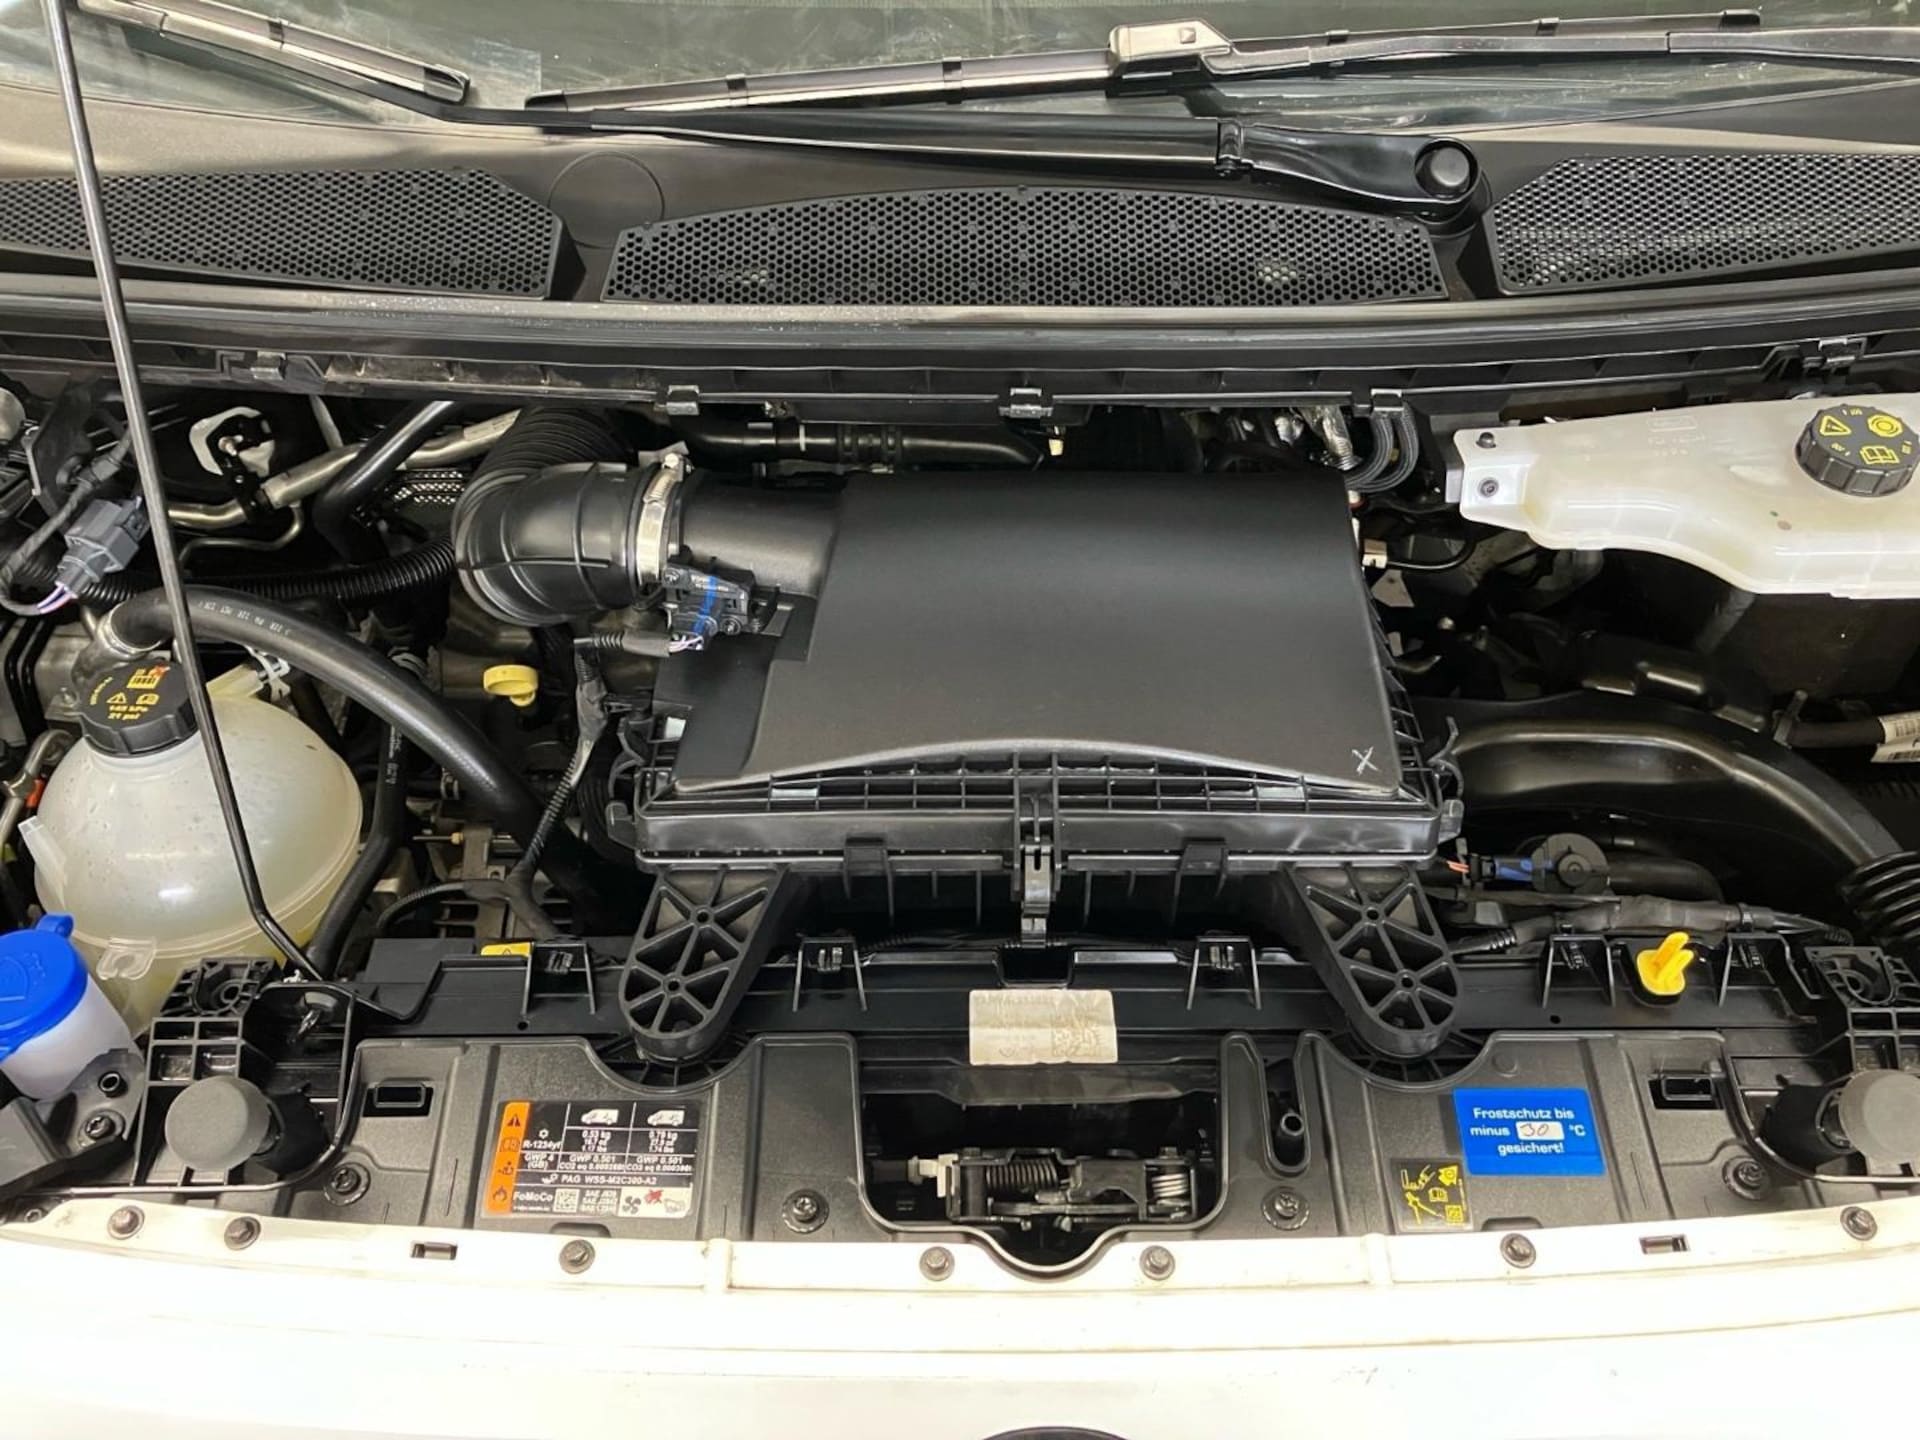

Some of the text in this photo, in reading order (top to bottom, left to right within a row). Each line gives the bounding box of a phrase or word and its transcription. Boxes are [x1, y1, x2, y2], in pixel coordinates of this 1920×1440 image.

[1473, 1107, 1575, 1119] Frostschutz bis
[1470, 1126, 1511, 1137] minus
[1569, 1124, 1586, 1136] °C
[522, 1140, 560, 1150] R-1234yf
[1497, 1142, 1565, 1157] gesichert!
[524, 1152, 547, 1161] GWP
[569, 1154, 592, 1162] GWP
[636, 1155, 659, 1163] GWP
[561, 1174, 582, 1184] PAG
[513, 1191, 554, 1202] FoMoCo
